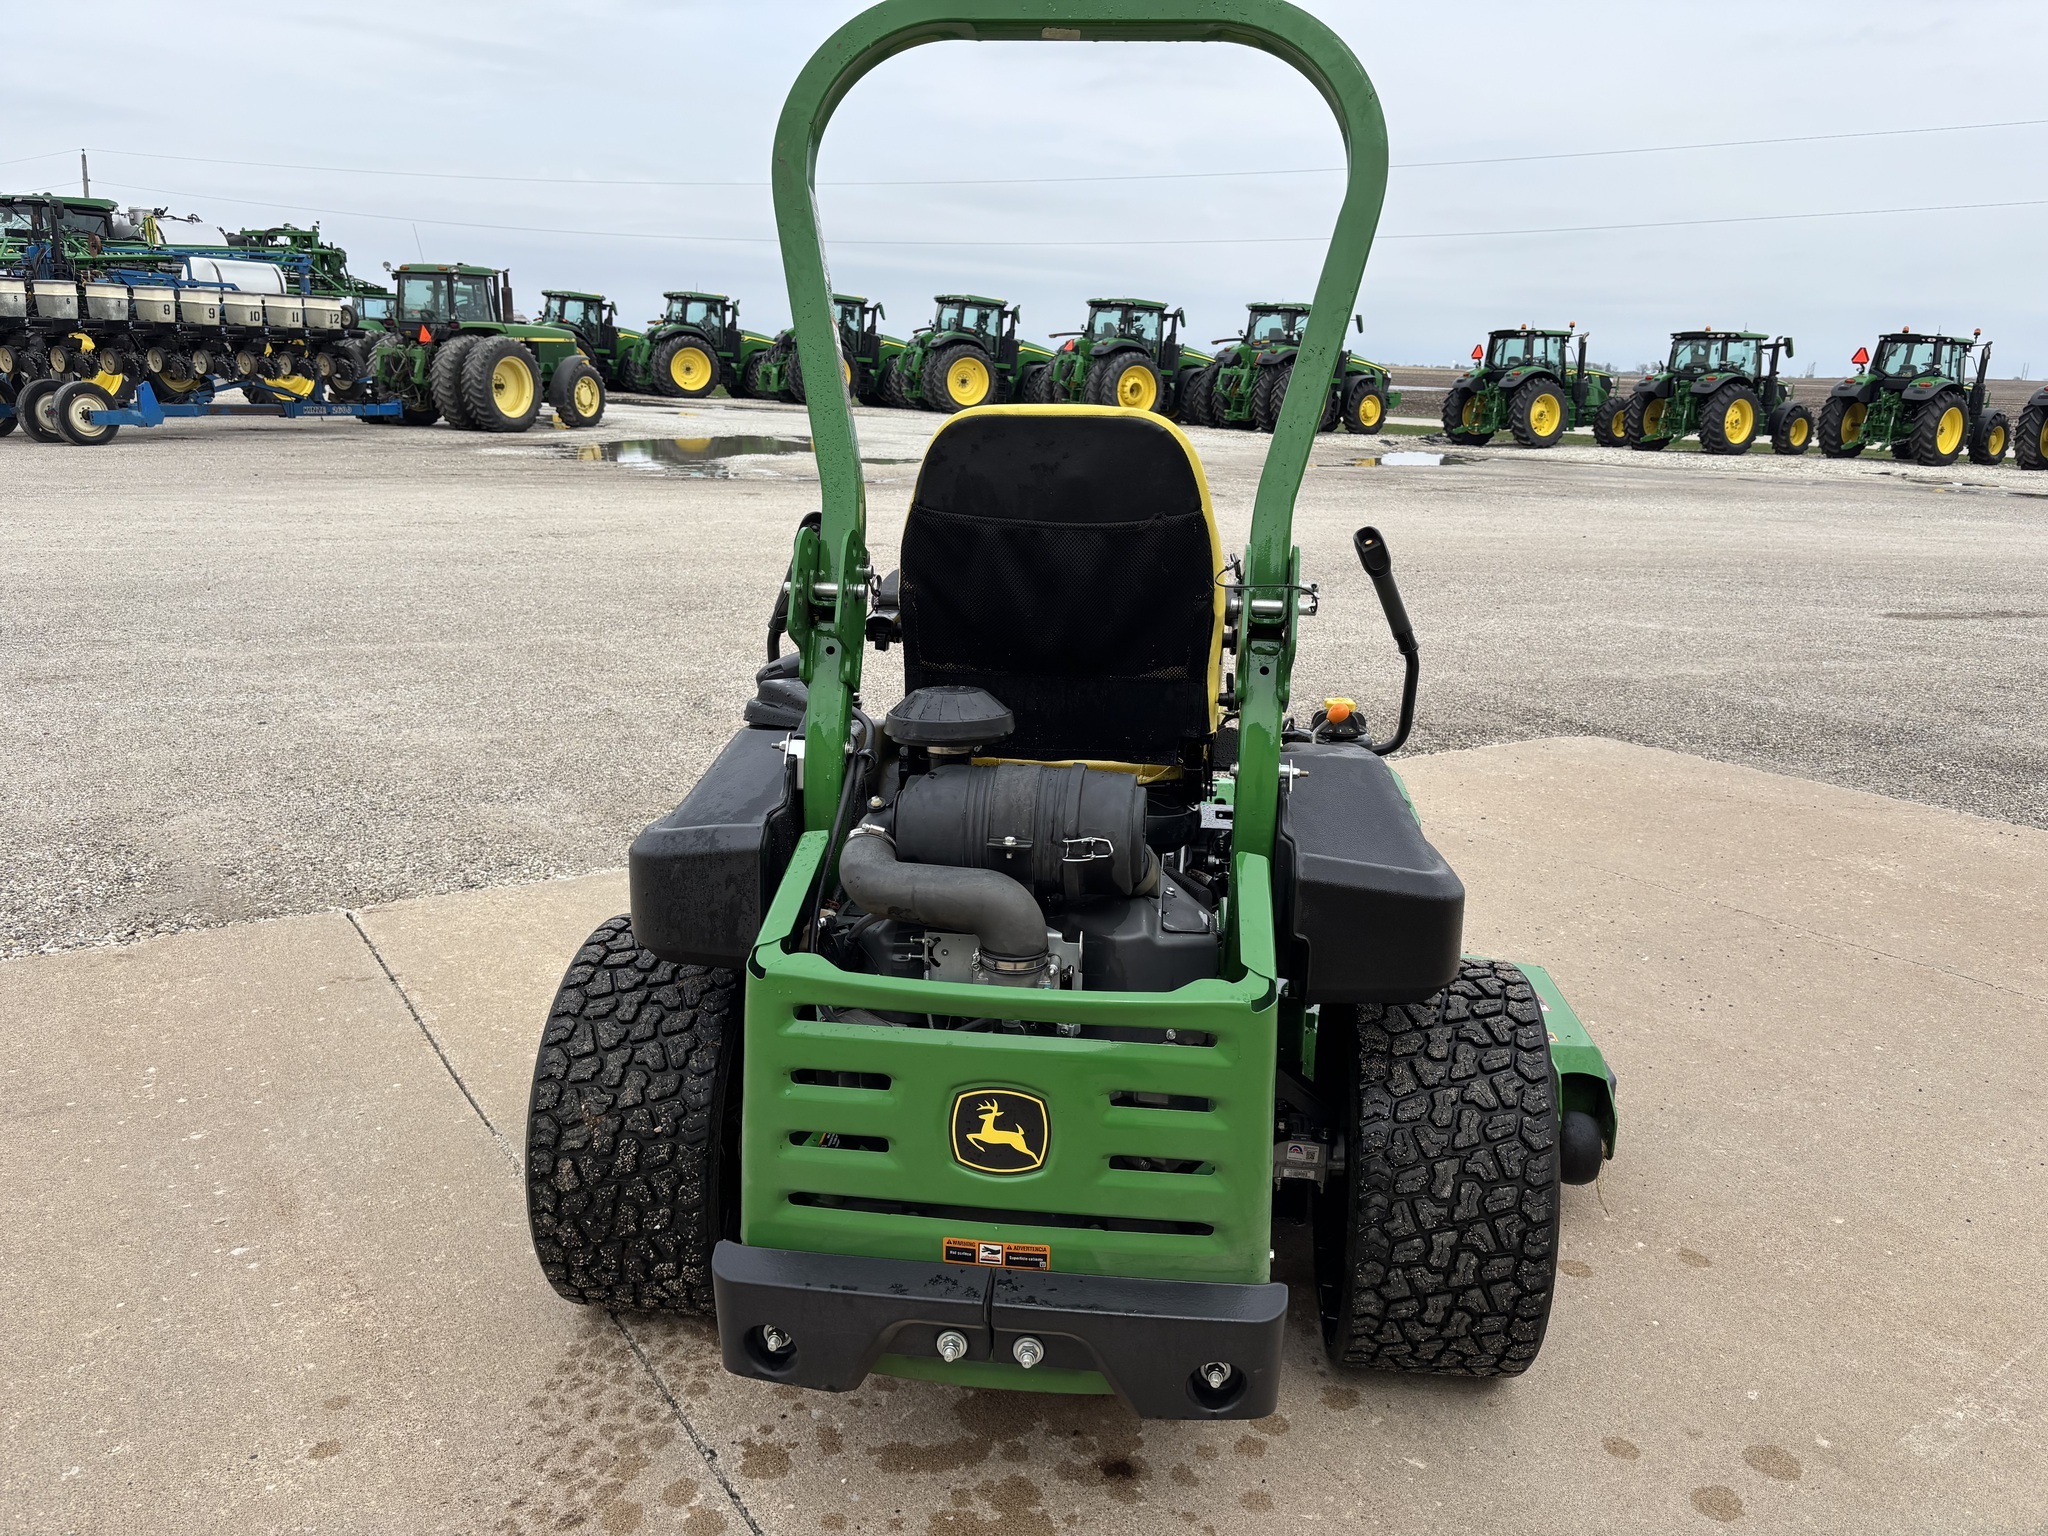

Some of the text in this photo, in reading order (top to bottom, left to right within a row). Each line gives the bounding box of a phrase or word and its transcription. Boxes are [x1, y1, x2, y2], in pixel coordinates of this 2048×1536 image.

[163, 304, 171, 315] 8
[208, 308, 215, 319] 9
[250, 311, 260, 321] 10
[292, 312, 299, 322] 11
[329, 314, 340, 324] 12
